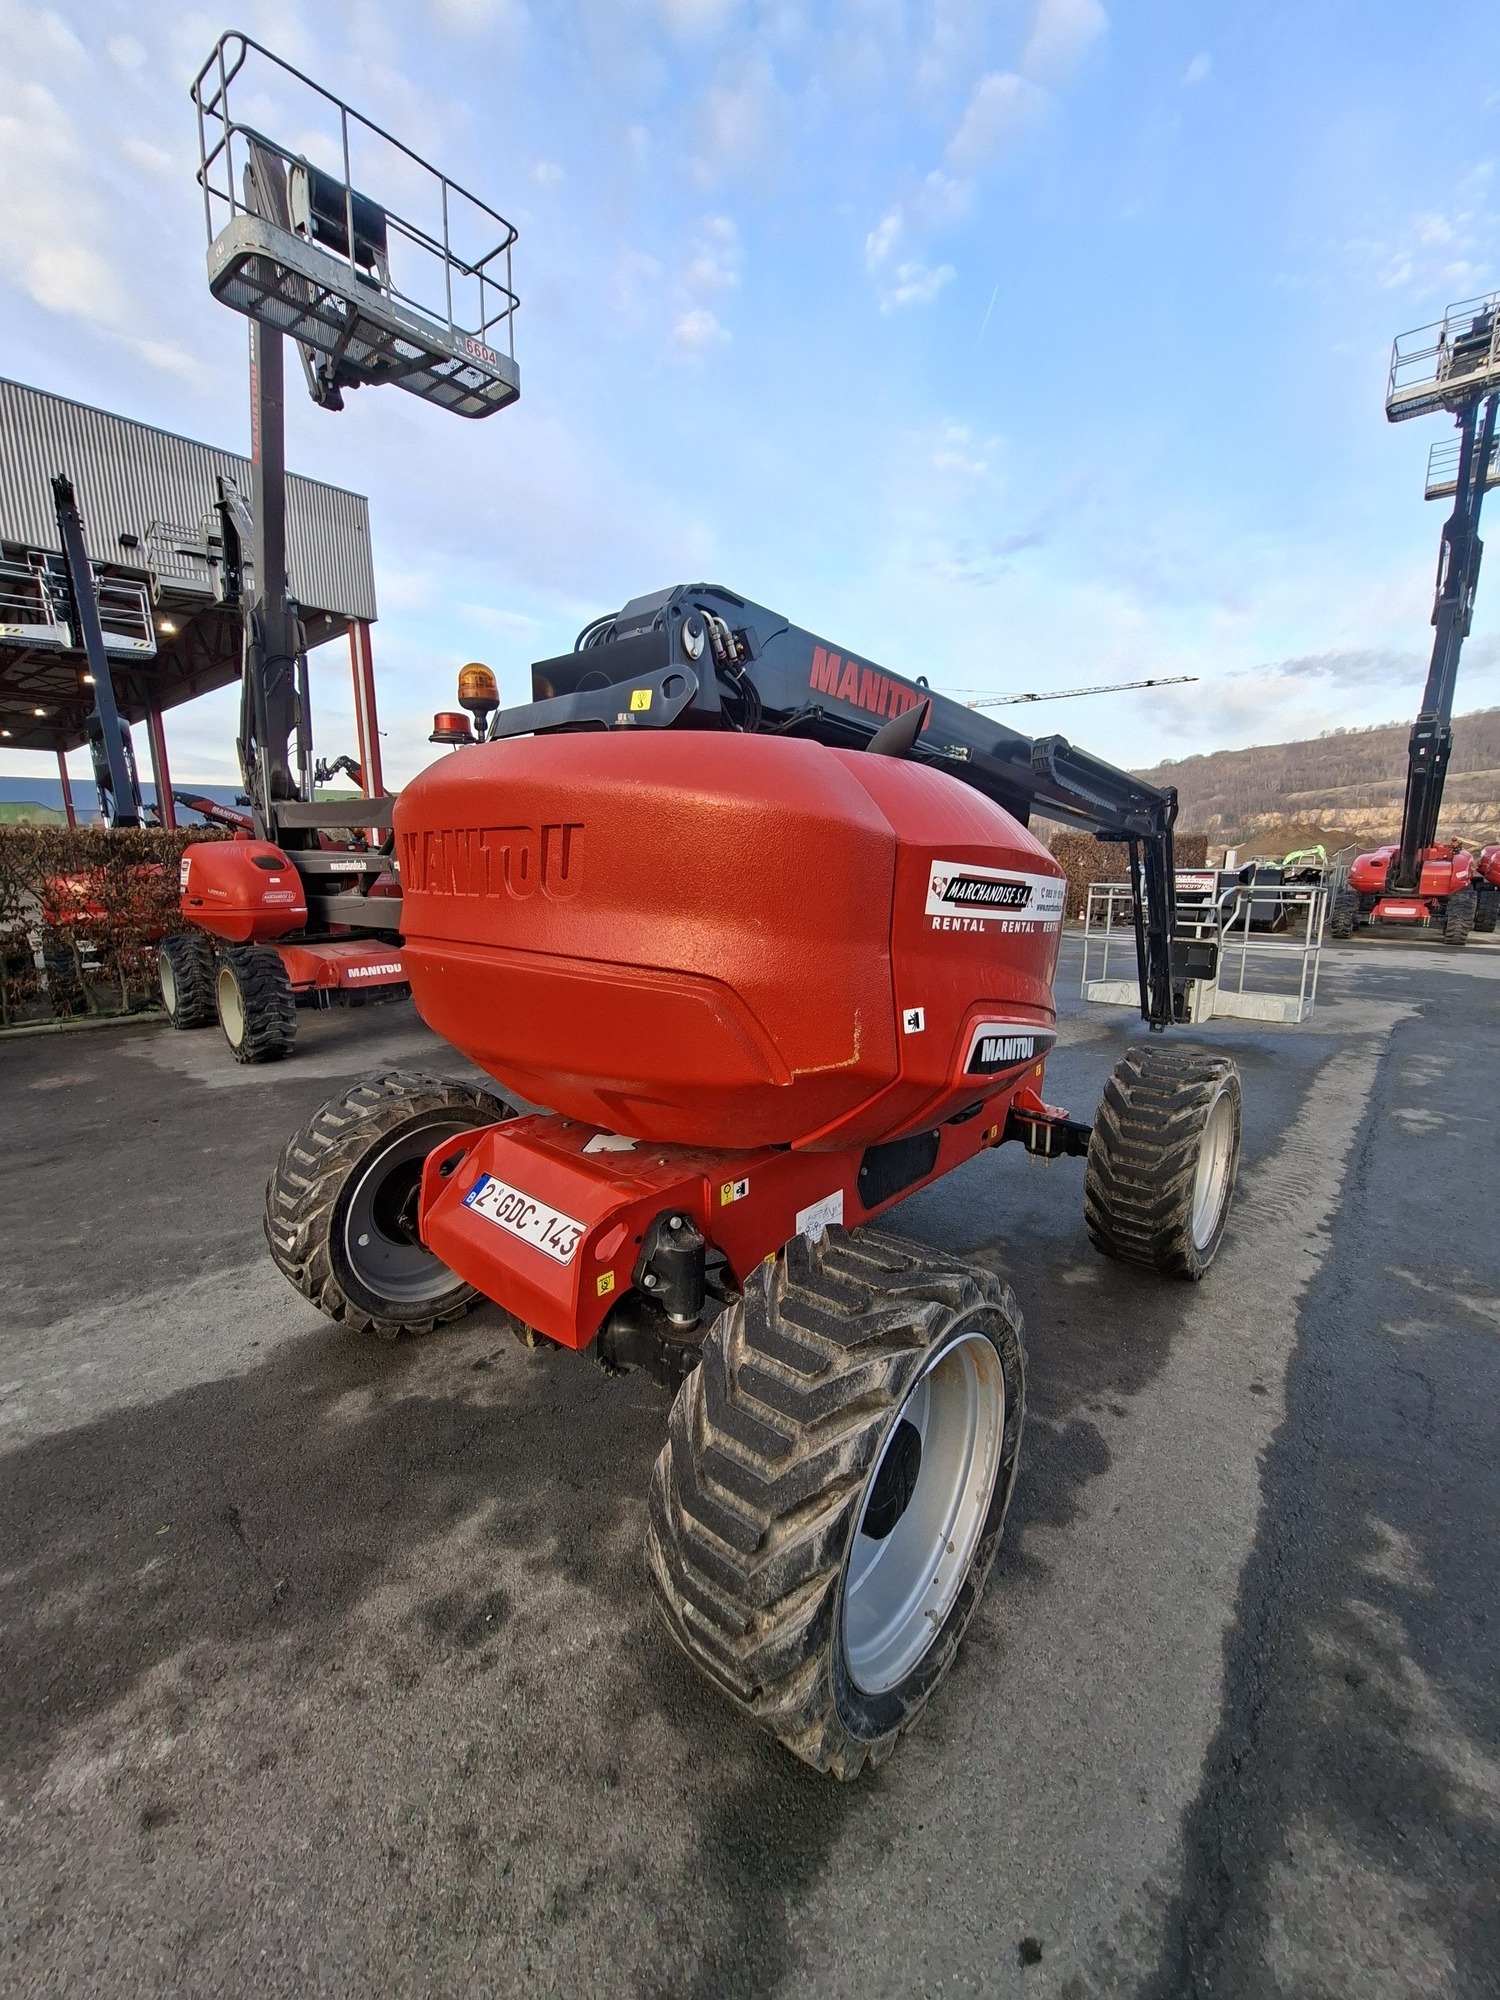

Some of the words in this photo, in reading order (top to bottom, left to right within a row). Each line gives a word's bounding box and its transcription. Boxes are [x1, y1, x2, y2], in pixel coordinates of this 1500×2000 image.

[466, 339, 496, 364] 6604
[211, 806, 244, 822] MANITOU
[402, 822, 585, 901] MANITOU
[946, 880, 1016, 904] MARCHANDISE
[931, 916, 986, 932] RENTAL
[1000, 921, 1035, 933] RENTAL
[347, 963, 402, 978] MANITOU
[981, 1037, 1034, 1063] MANITOU
[465, 1191, 477, 1203] B
